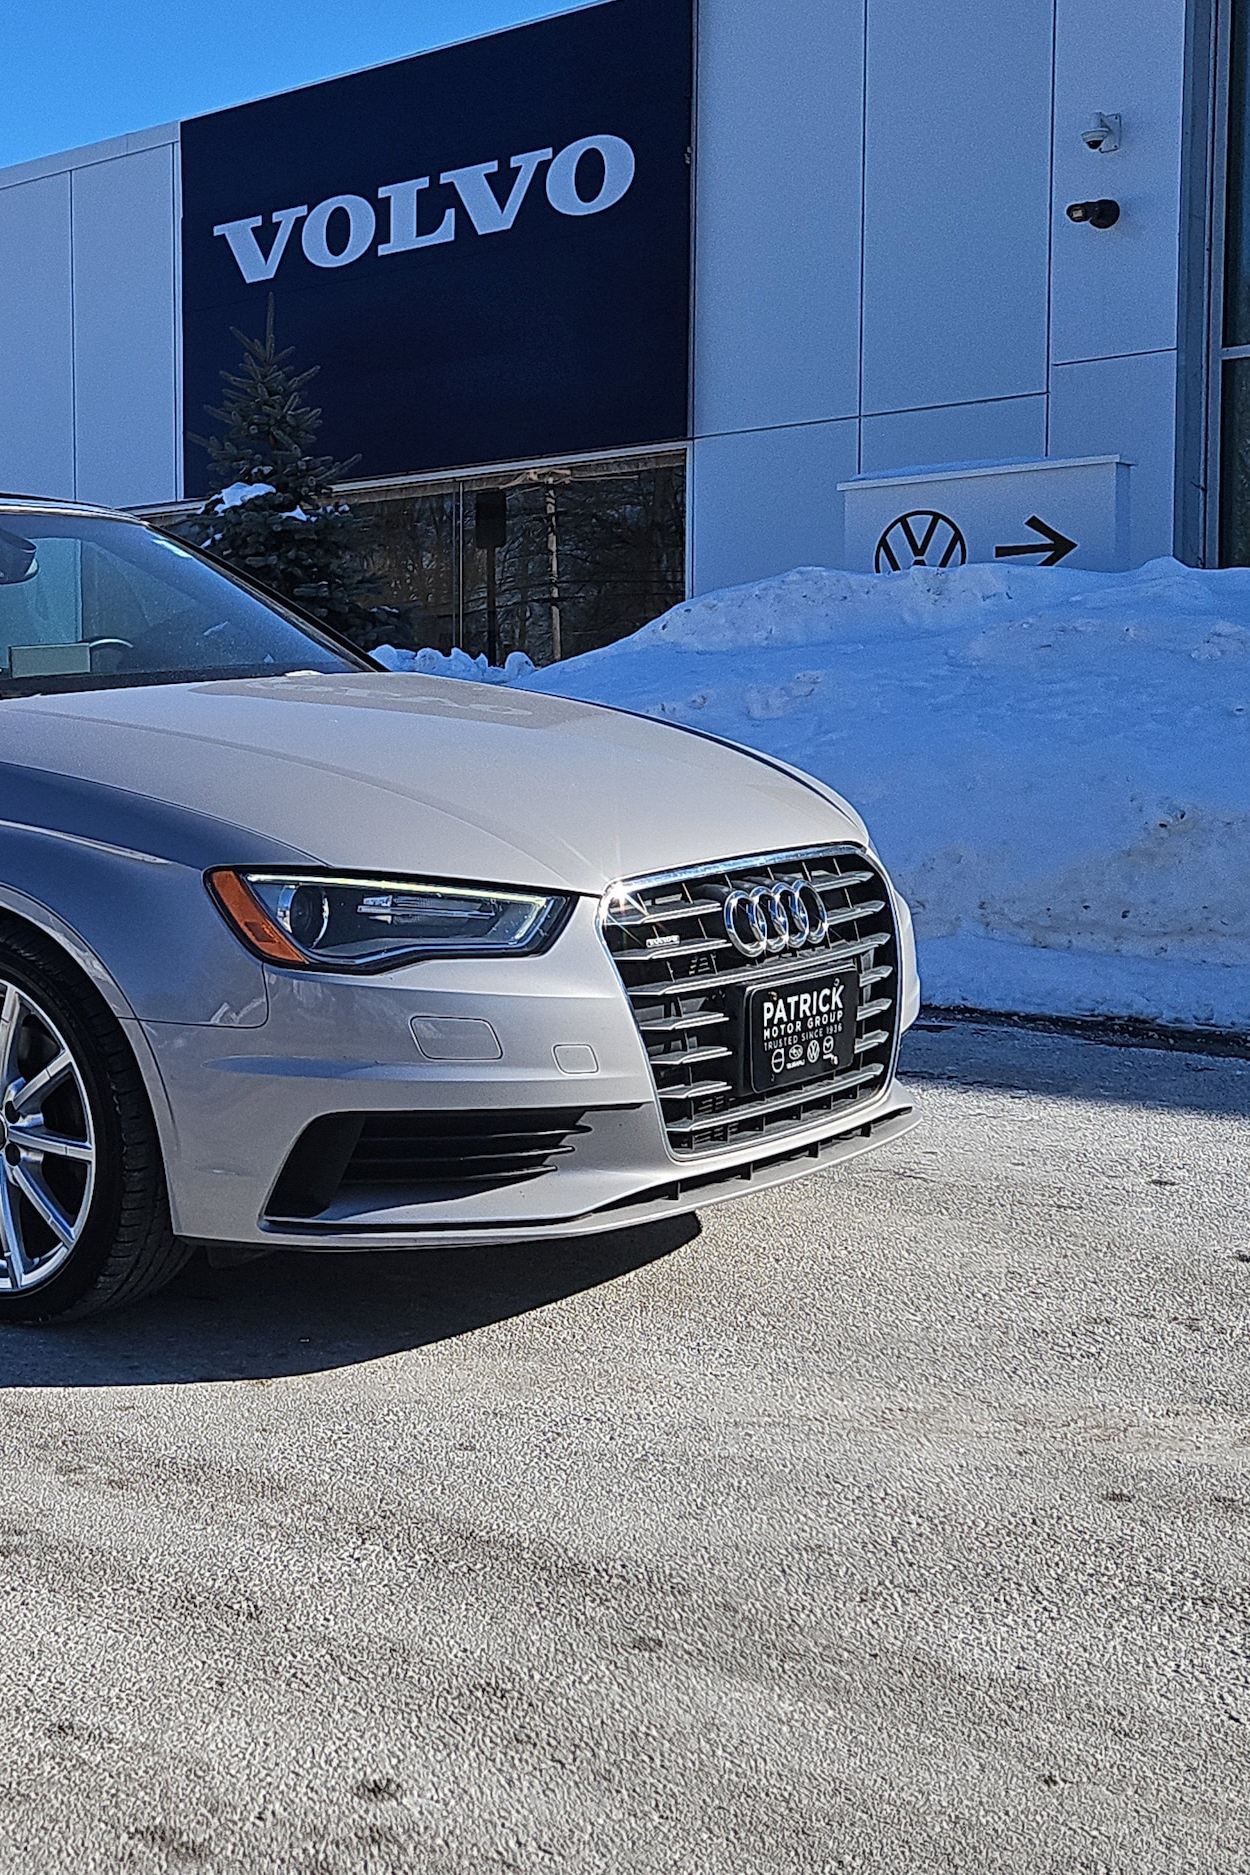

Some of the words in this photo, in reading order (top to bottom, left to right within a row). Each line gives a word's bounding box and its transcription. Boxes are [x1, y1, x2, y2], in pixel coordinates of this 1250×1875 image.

[213, 134, 636, 284] VOLVO
[763, 985, 844, 1027] PATRICK
[763, 1021, 802, 1040] MOTOR
[807, 1010, 843, 1029] GROUP
[764, 1035, 798, 1051] TRUSTED
[801, 1028, 823, 1041] SINCE
